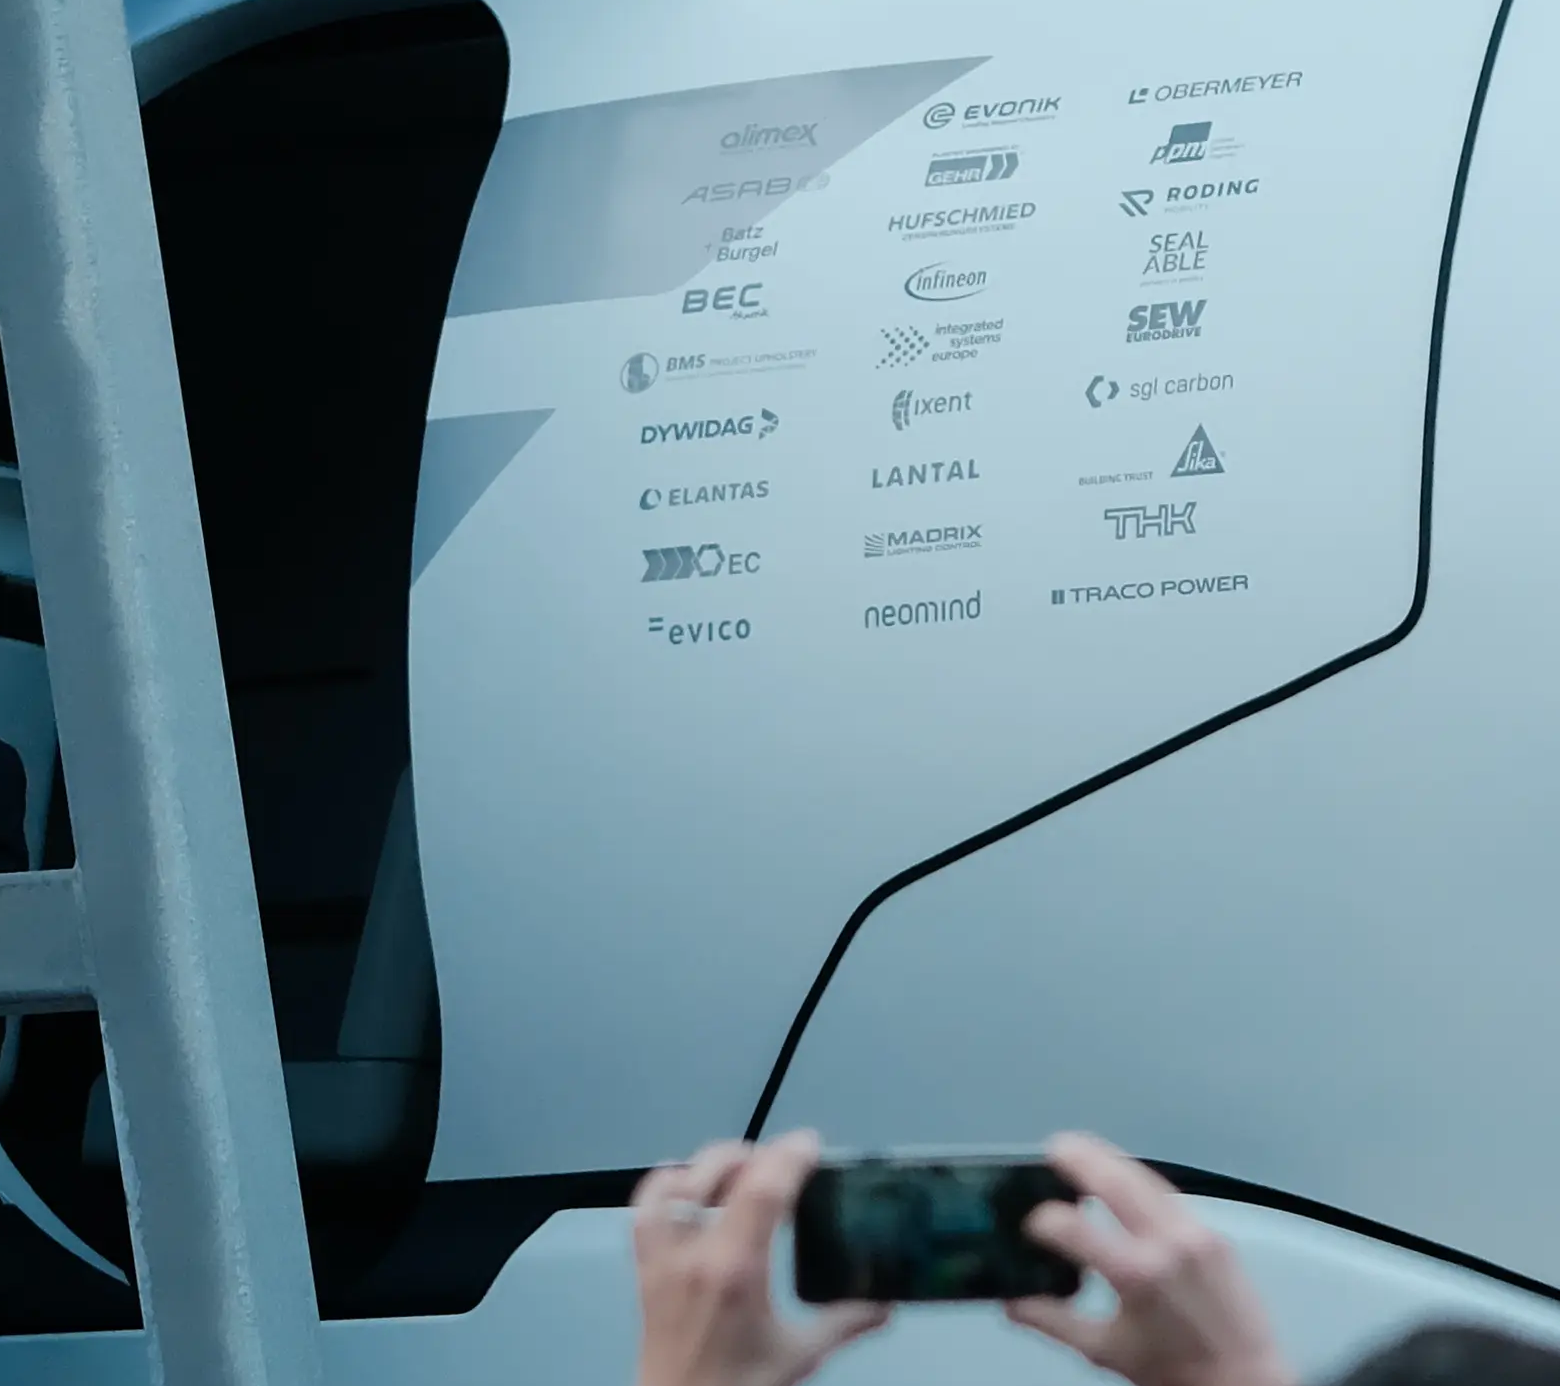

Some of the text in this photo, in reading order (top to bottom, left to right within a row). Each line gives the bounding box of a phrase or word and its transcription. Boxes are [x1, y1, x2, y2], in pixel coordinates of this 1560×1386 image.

[1154, 71, 1303, 101] OBERMEYER
[964, 96, 1062, 120] EVONIK
[720, 123, 818, 149] alimex
[928, 168, 982, 185] GEHR
[1166, 178, 1260, 202] RODING
[888, 202, 1036, 232] HUFSCHMIED
[721, 226, 764, 243] Batz
[1149, 230, 1209, 254] SEAL
[1142, 250, 1208, 275] ABLE
[682, 282, 763, 314] BEC
[935, 318, 1004, 336] integrated
[1127, 299, 1208, 332] SEW
[950, 333, 1002, 349] systems
[1126, 326, 1202, 343] EURODRIVE
[666, 354, 706, 372] BMS
[932, 348, 978, 362] europe
[1130, 373, 1234, 401] sgl carbon
[641, 415, 754, 444] DYWIDAG
[1177, 440, 1217, 472] Sika
[872, 459, 980, 489] LANTAL
[1124, 471, 1153, 483] TRUST
[668, 479, 769, 507] ELANTAS
[1104, 501, 1197, 540] THK
[888, 524, 982, 547] MADRIX
[1070, 574, 1249, 603] TRACO POWER
[865, 589, 981, 629] neomind
[668, 618, 751, 645] evico
